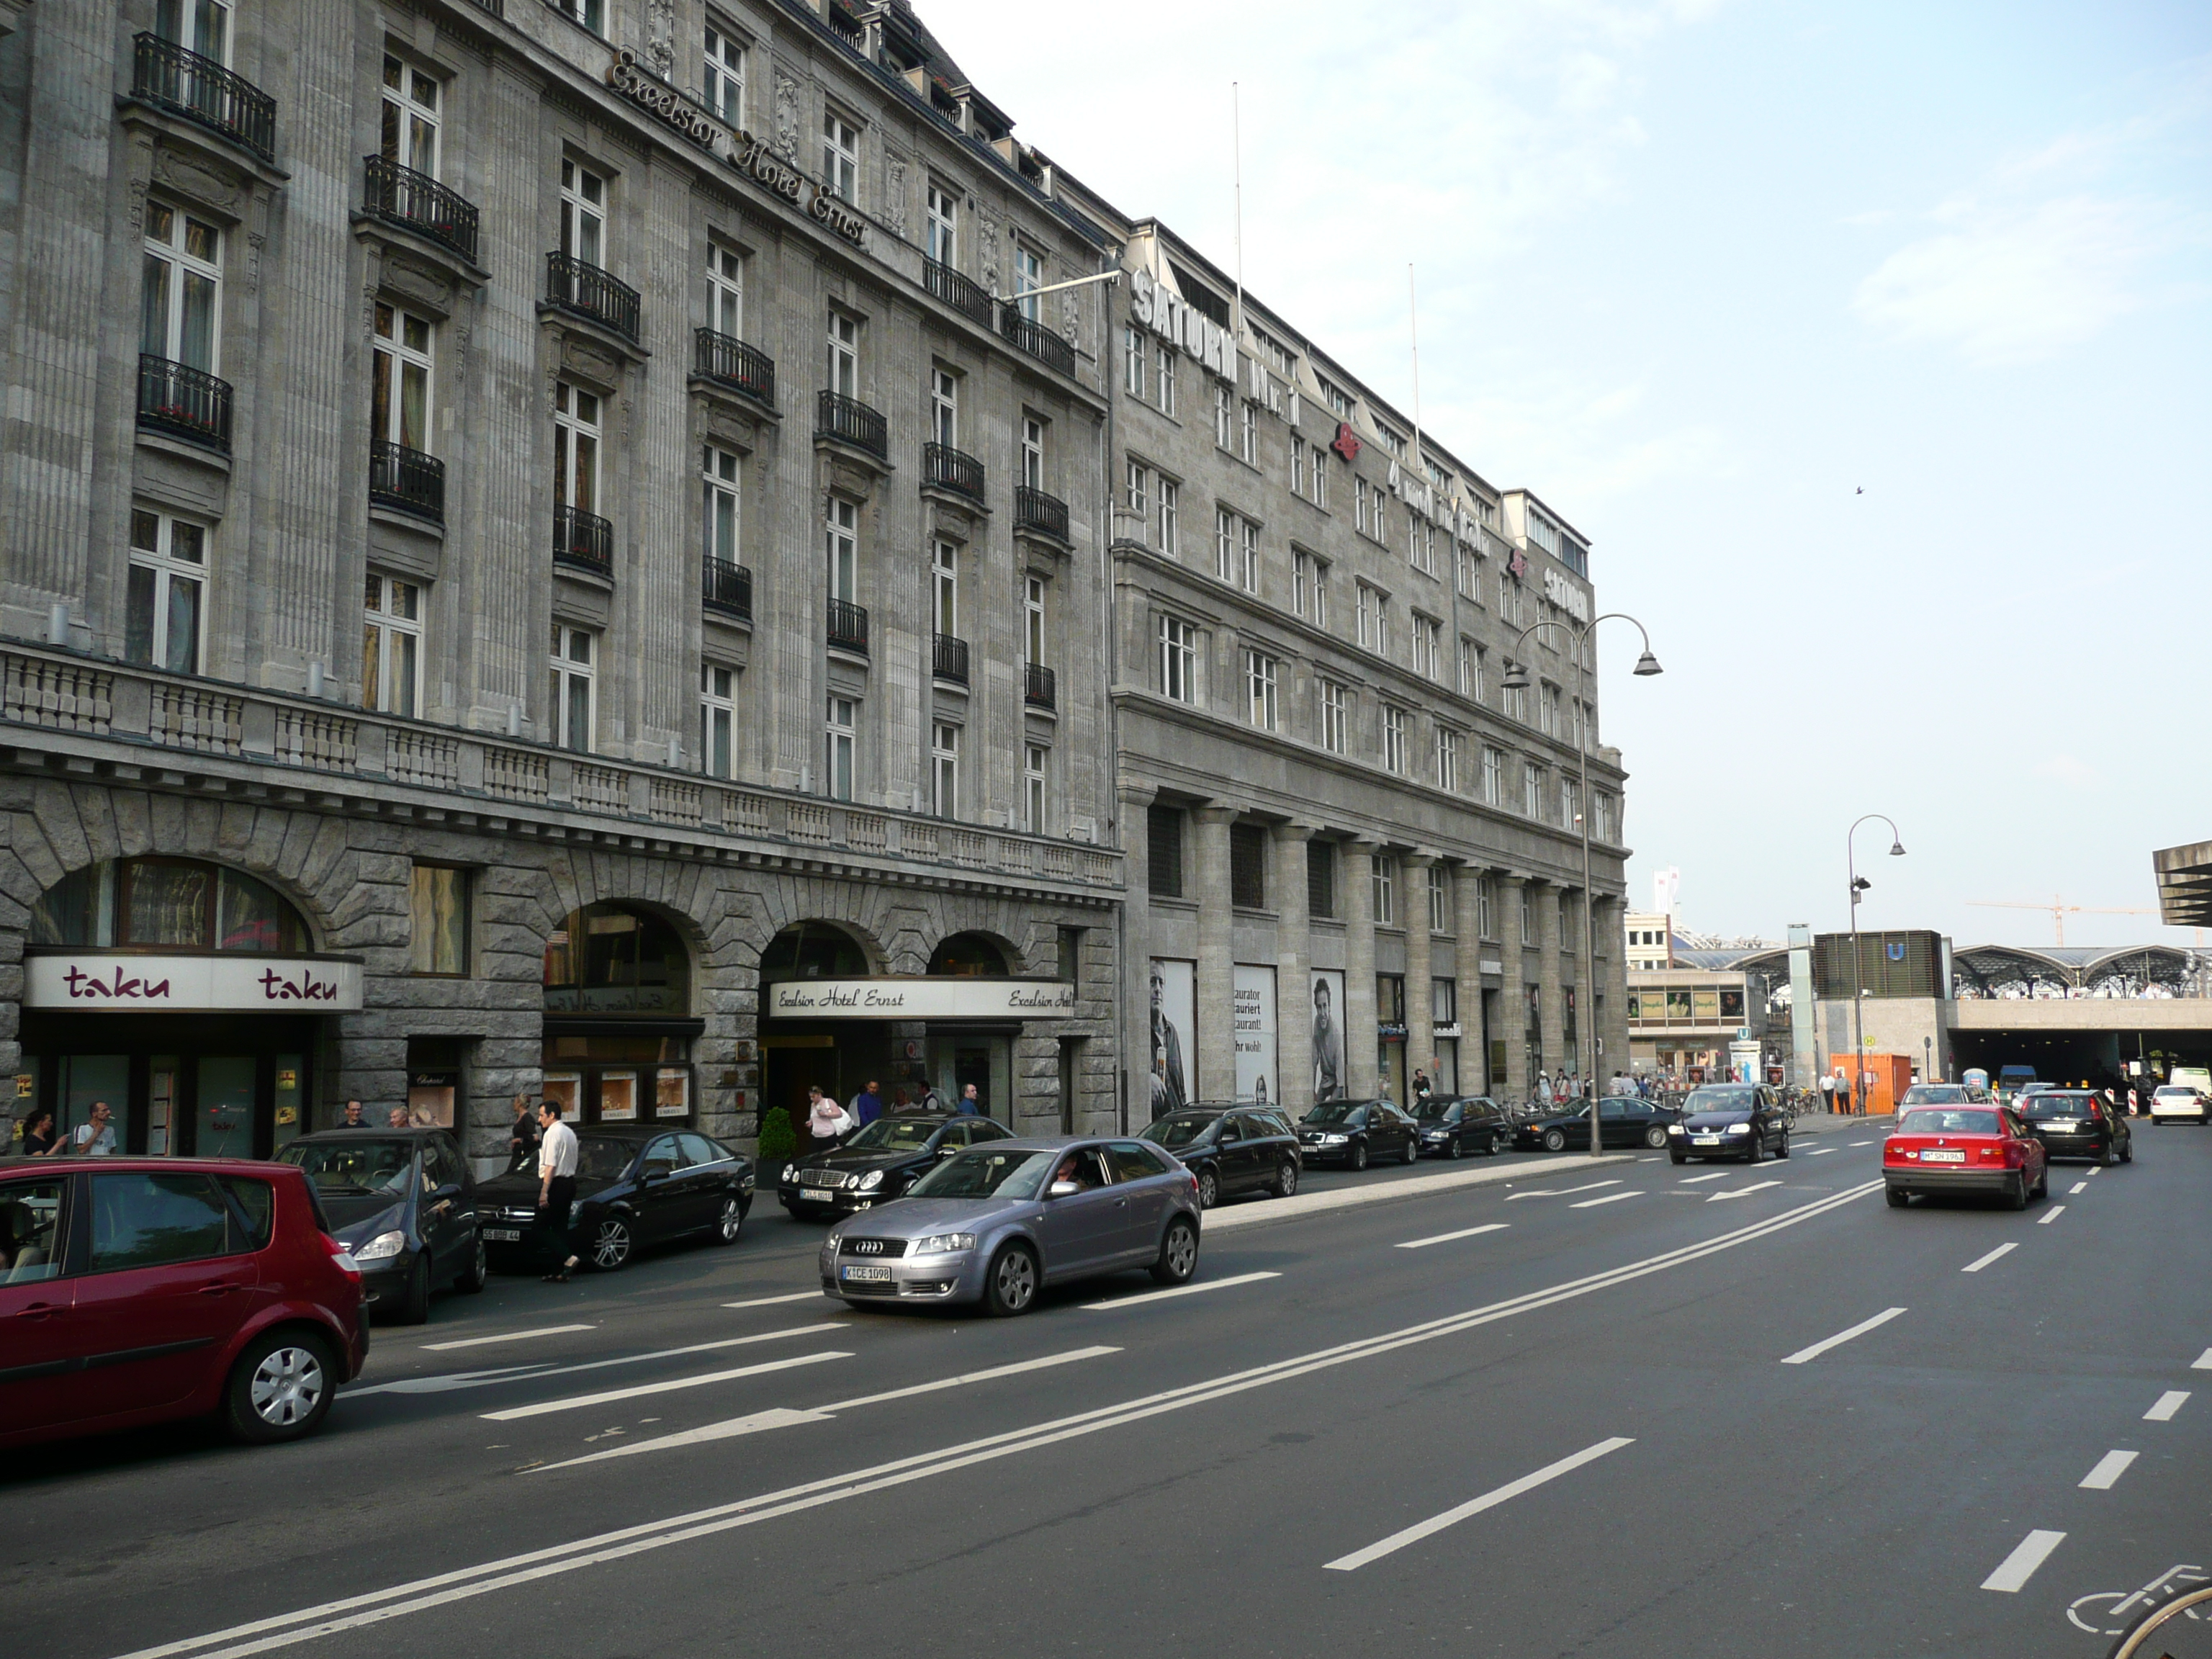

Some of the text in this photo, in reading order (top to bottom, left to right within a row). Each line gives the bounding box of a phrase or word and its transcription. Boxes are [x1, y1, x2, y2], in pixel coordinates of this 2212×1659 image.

[606, 50, 868, 246] Excelsior Hotel Ernst
[1131, 267, 1300, 427] SATURN Nr. 1
[1544, 567, 1588, 624] SATURN
[1888, 944, 1904, 960] U
[63, 965, 170, 999] taku
[258, 968, 337, 1001] taku
[779, 985, 904, 1007] Excelsior Hotel Ernst
[1008, 989, 1053, 1007] Excelsior
[1234, 989, 1260, 1001] aurator
[1235, 1018, 1262, 1030] aurant!
[1740, 1029, 1748, 1038] U
[847, 1268, 889, 1280] K CE 1098
